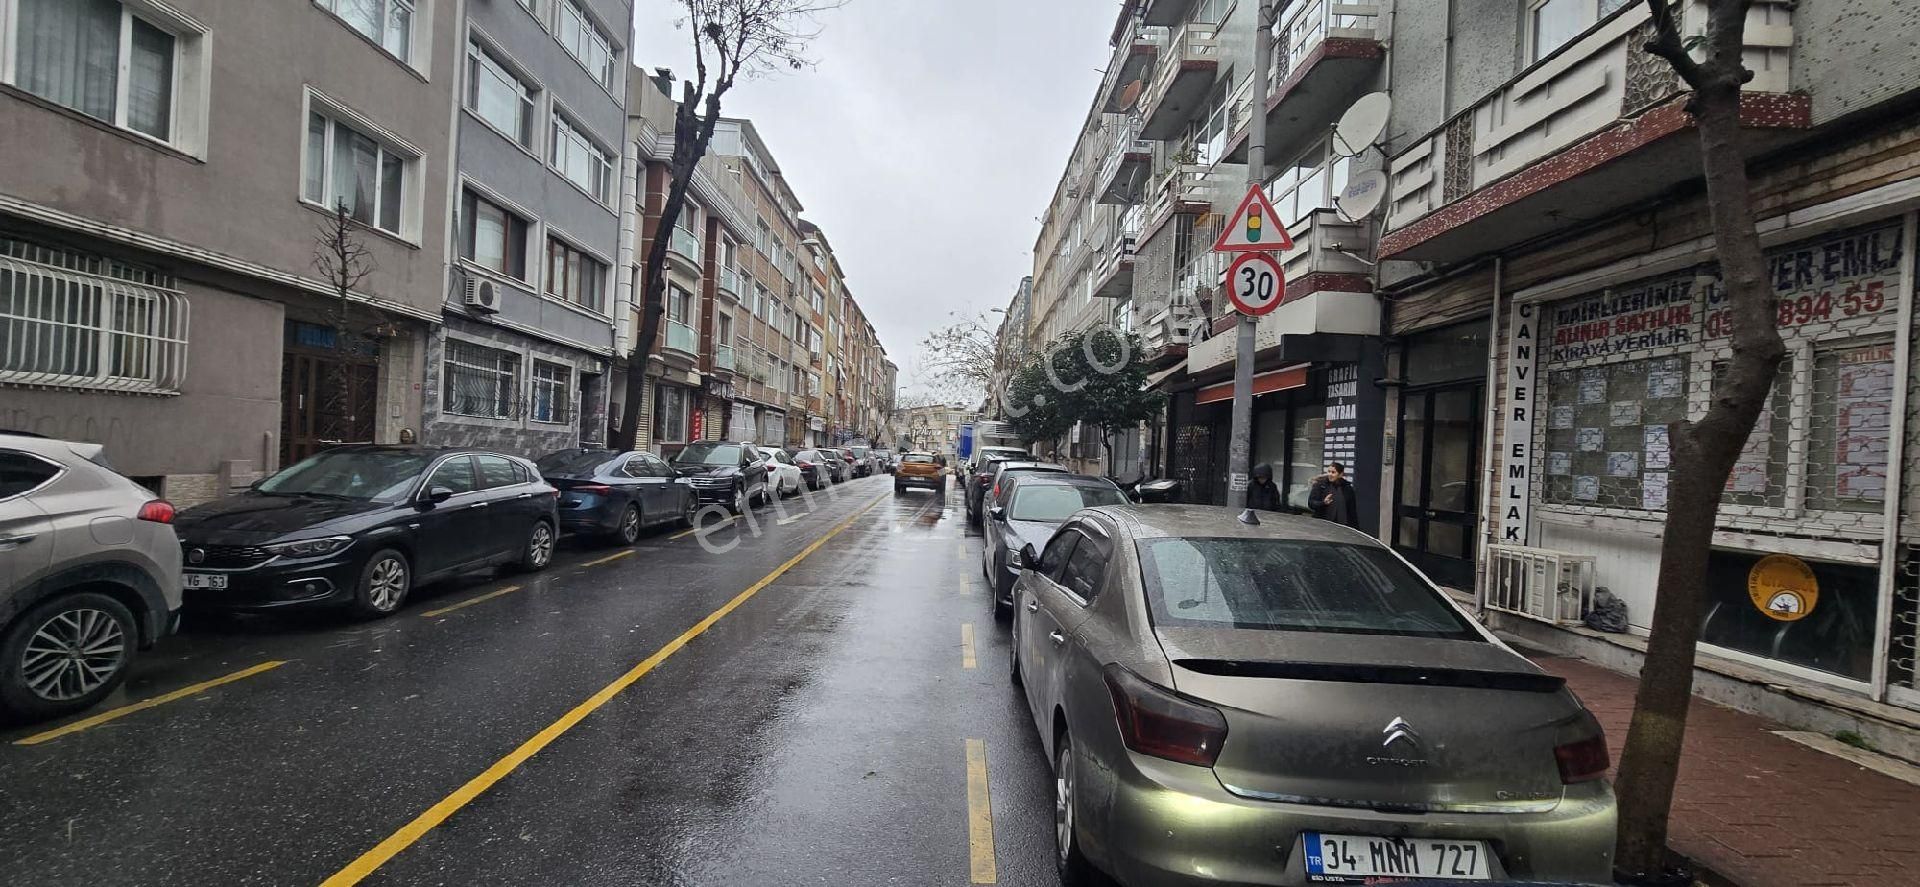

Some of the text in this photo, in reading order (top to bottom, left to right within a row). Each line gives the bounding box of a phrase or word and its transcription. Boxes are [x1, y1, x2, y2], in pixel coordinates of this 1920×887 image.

[1241, 266, 1274, 301] 30
[1843, 281, 1885, 316] 55
[1513, 303, 1532, 422] CANVER
[1505, 443, 1525, 541] EMLAK
[208, 575, 225, 588] 163
[1309, 839, 1477, 876] TR 34 MNM 727
